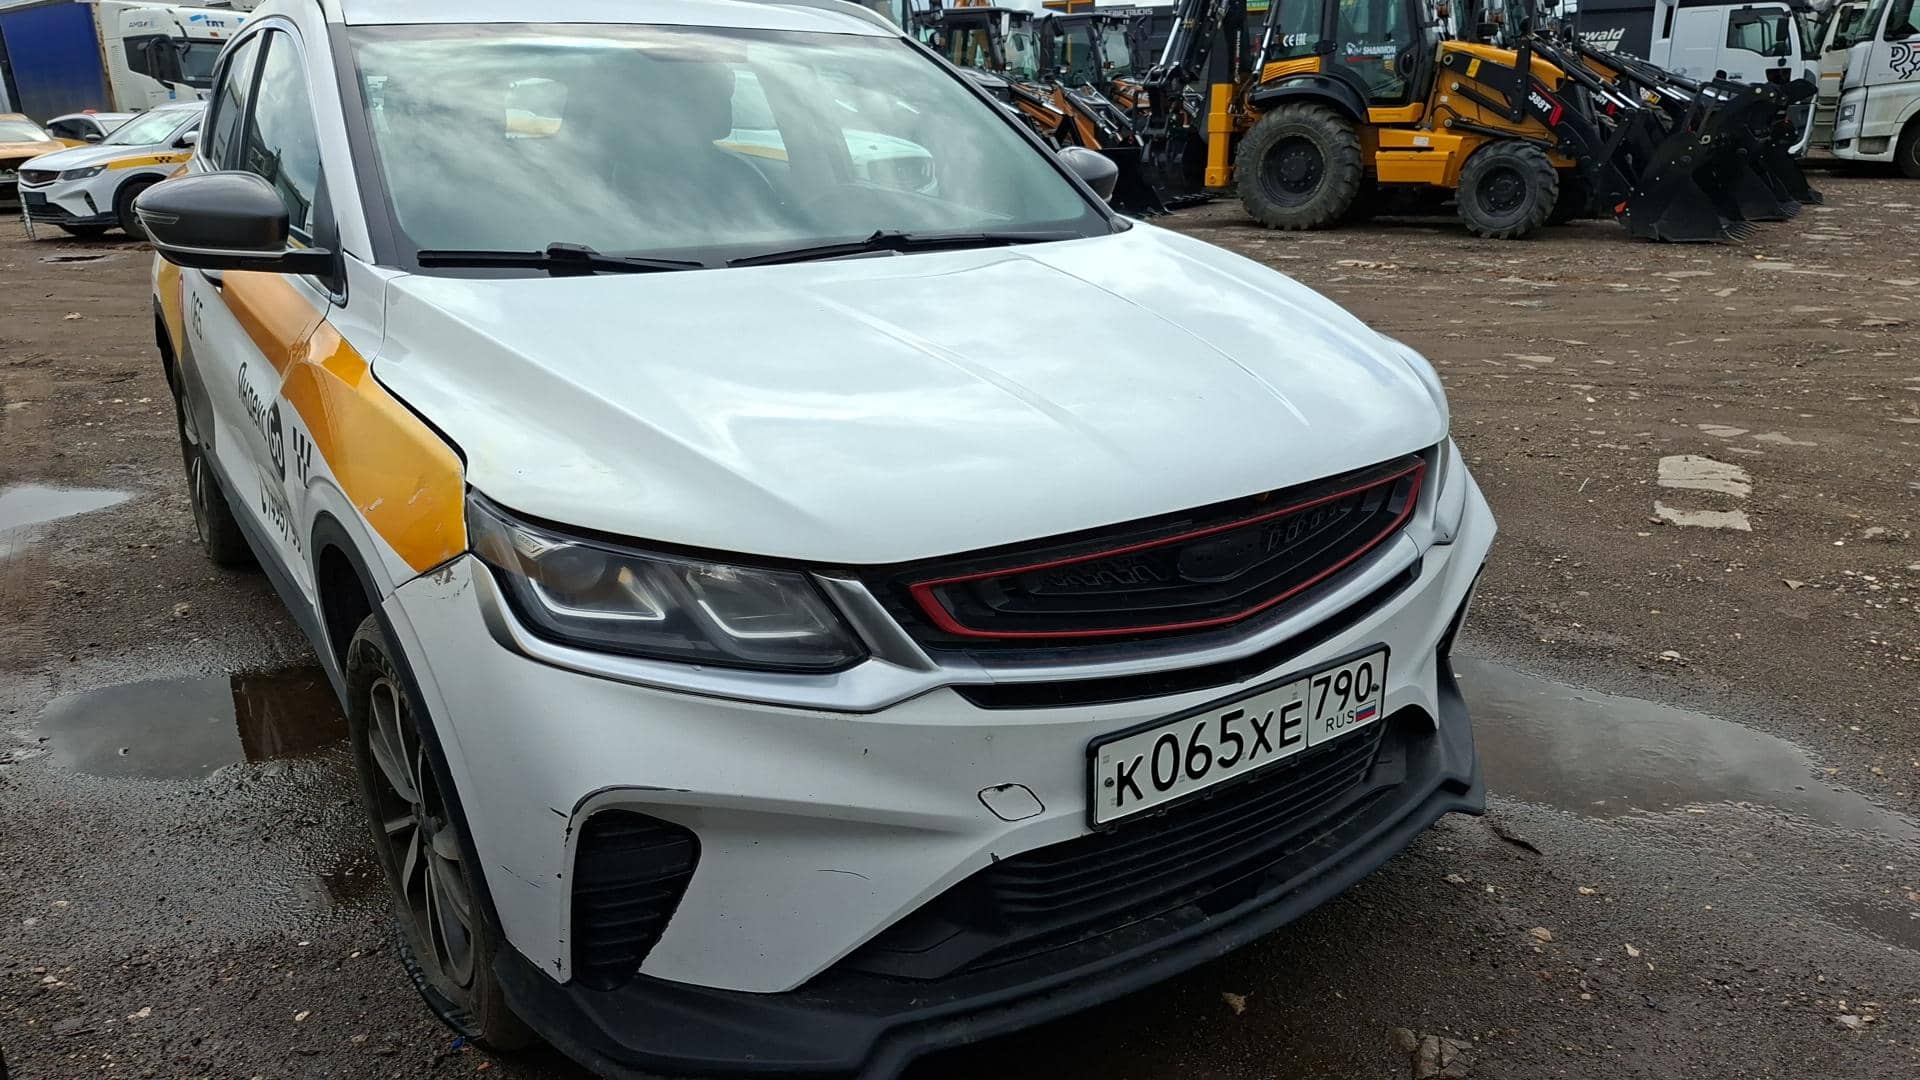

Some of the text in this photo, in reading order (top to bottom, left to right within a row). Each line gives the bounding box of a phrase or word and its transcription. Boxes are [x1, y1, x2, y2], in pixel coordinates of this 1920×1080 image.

[1362, 45, 1397, 55] SHANNON
[1528, 91, 1552, 113] 388T
[1312, 661, 1373, 721] 790
[1325, 709, 1355, 733] RUS
